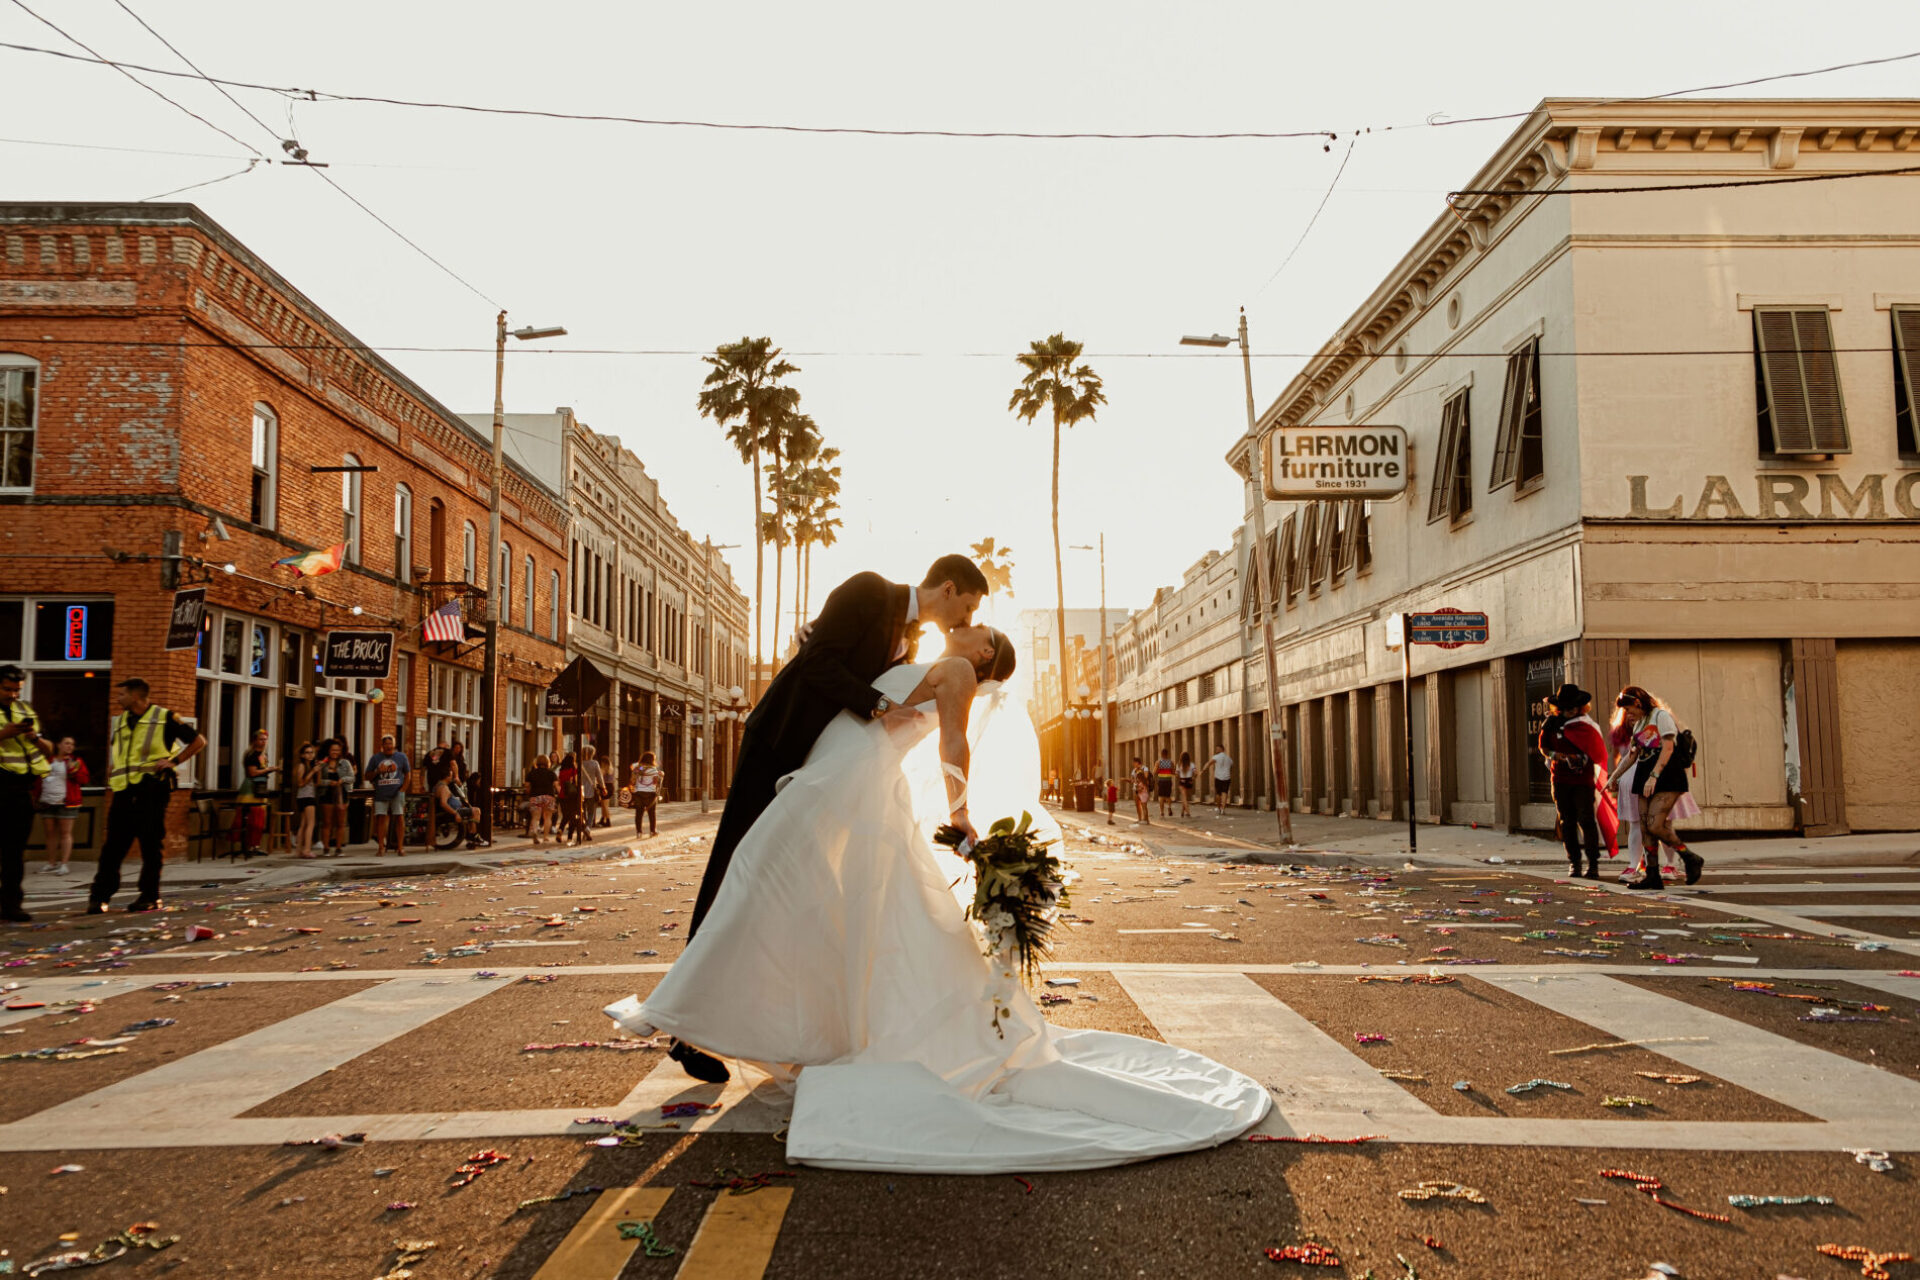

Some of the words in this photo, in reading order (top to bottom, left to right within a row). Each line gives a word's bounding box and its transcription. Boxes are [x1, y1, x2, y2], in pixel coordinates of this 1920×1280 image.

[1280, 435, 1398, 457] LARMON
[1280, 458, 1400, 479] furniture
[1315, 480, 1342, 489] Since
[1345, 480, 1367, 488] 1931
[69, 608, 84, 658] OPEN
[1464, 630, 1478, 641] St
[331, 640, 351, 659] THE
[351, 639, 388, 663] BRICKS
